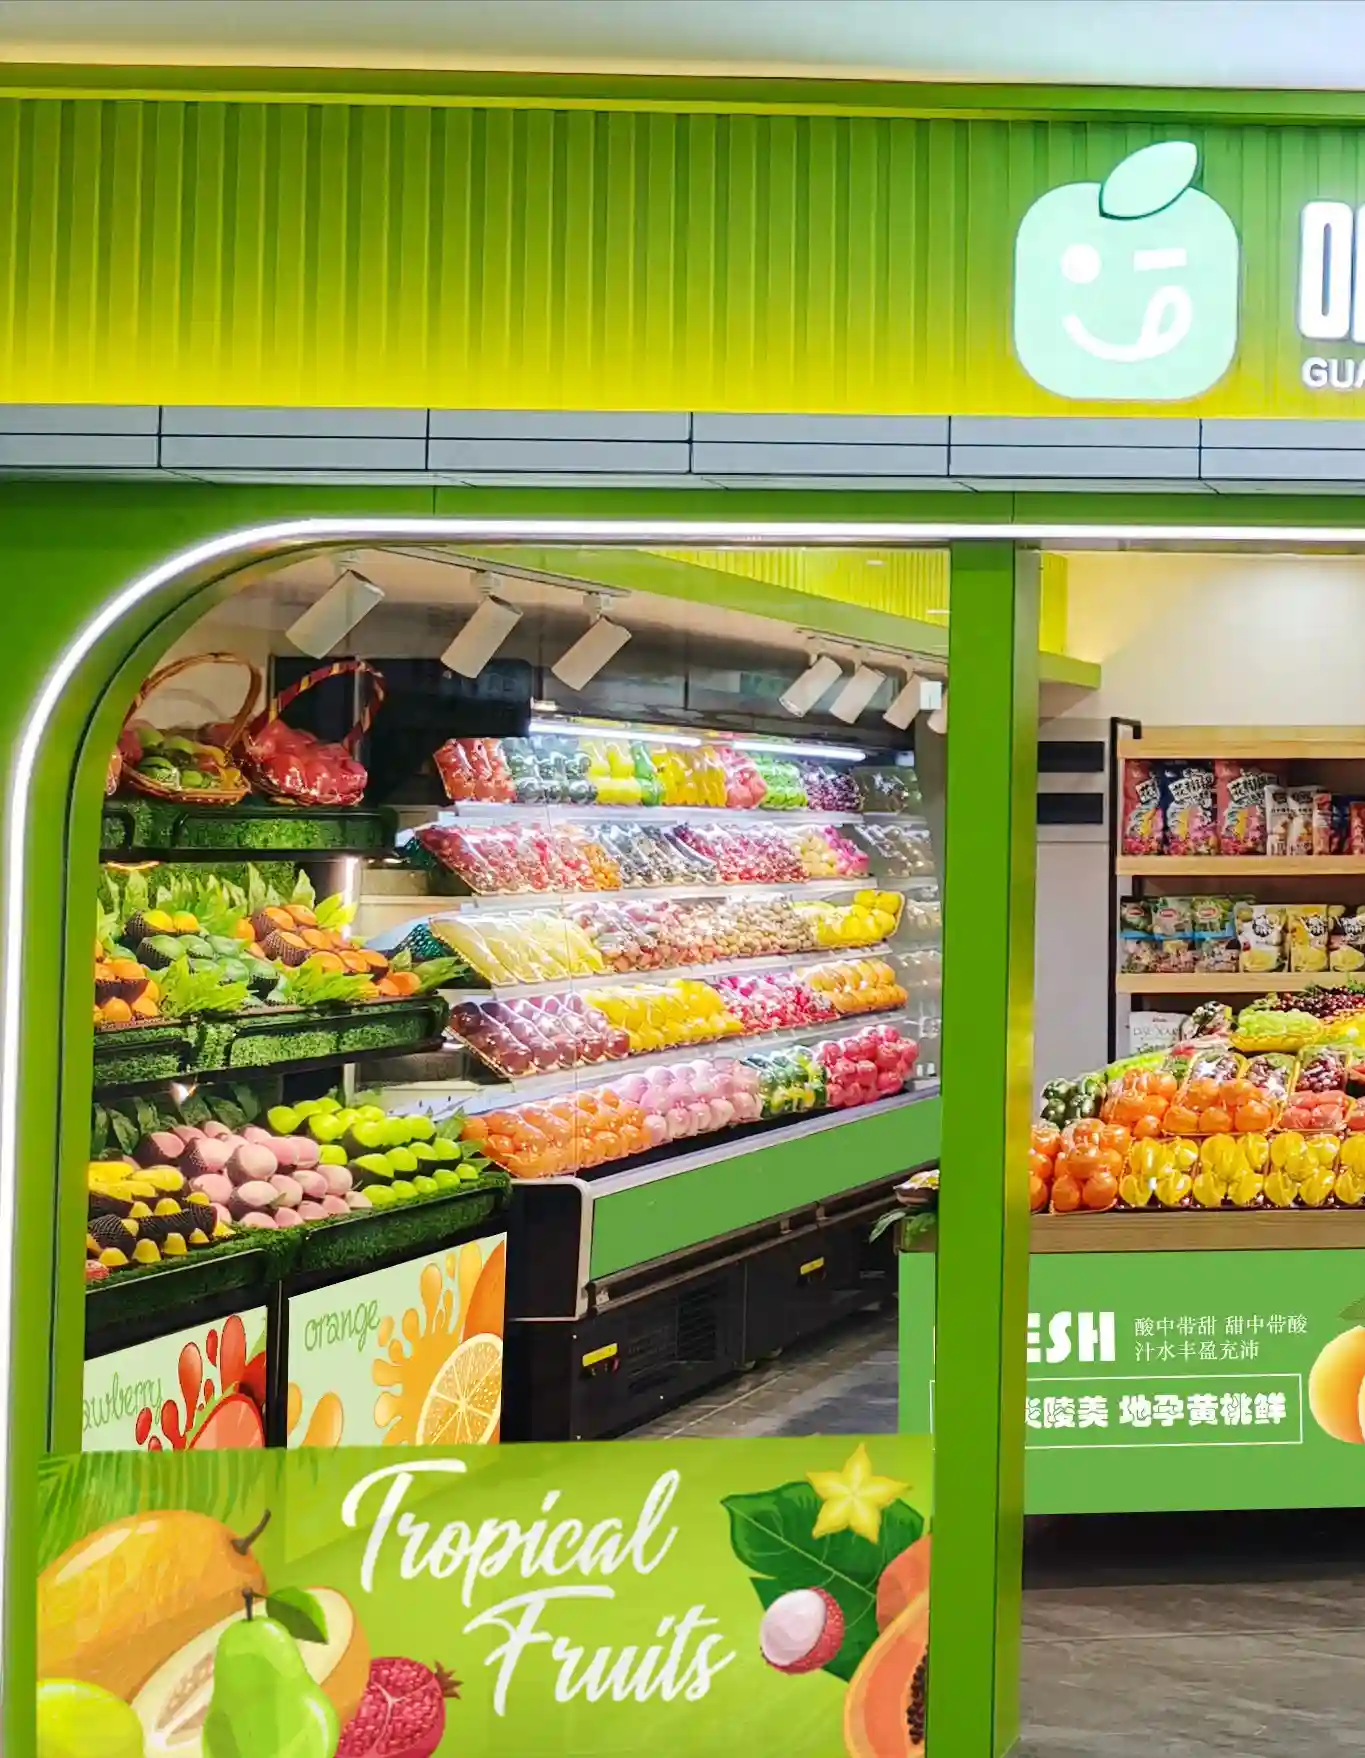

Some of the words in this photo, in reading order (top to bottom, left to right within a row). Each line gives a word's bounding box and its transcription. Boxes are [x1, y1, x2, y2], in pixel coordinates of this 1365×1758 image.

[304, 1299, 382, 1352] orange
[1134, 1315, 1218, 1337] 酸中带甜
[1225, 1313, 1309, 1336] 甜中带酸
[1134, 1339, 1261, 1363] 汁水丰盈充沛
[1118, 1392, 1287, 1428] 地孕黄桃鲜
[341, 1458, 682, 1608] Tropical
[464, 1585, 736, 1718] Fruits
